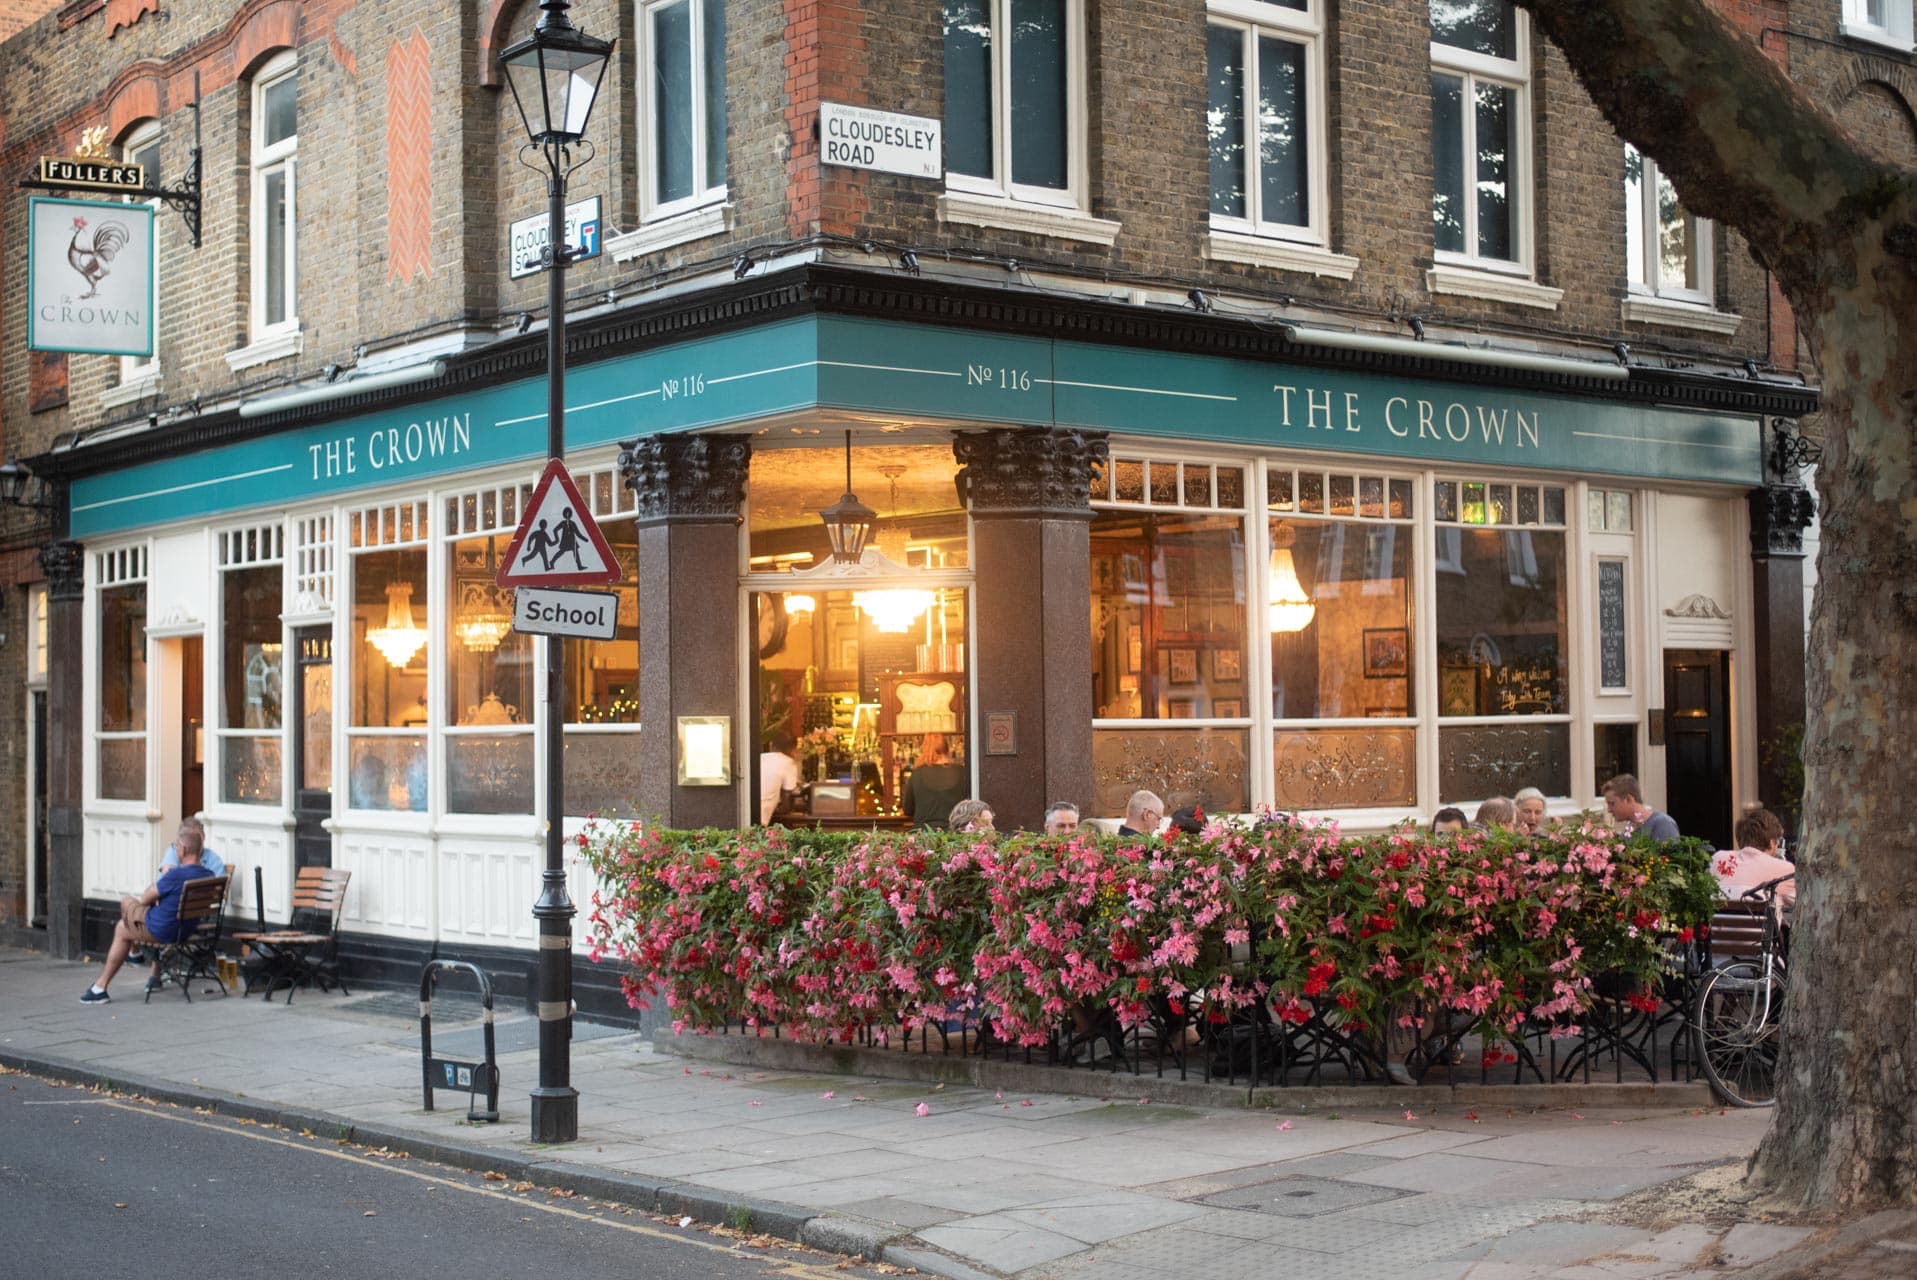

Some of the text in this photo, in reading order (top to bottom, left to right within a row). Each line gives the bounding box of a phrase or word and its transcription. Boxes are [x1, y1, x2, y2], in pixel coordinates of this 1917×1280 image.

[828, 117, 935, 151] CLOUDESLEY
[828, 141, 875, 165] ROAD
[48, 161, 137, 184] FULLER'S
[40, 304, 141, 327] CROWN
[683, 373, 705, 397] 116
[999, 367, 1031, 392] 116
[1273, 384, 1539, 449] THE CROWN
[309, 412, 471, 481] THE CROWN
[525, 600, 606, 627] School
